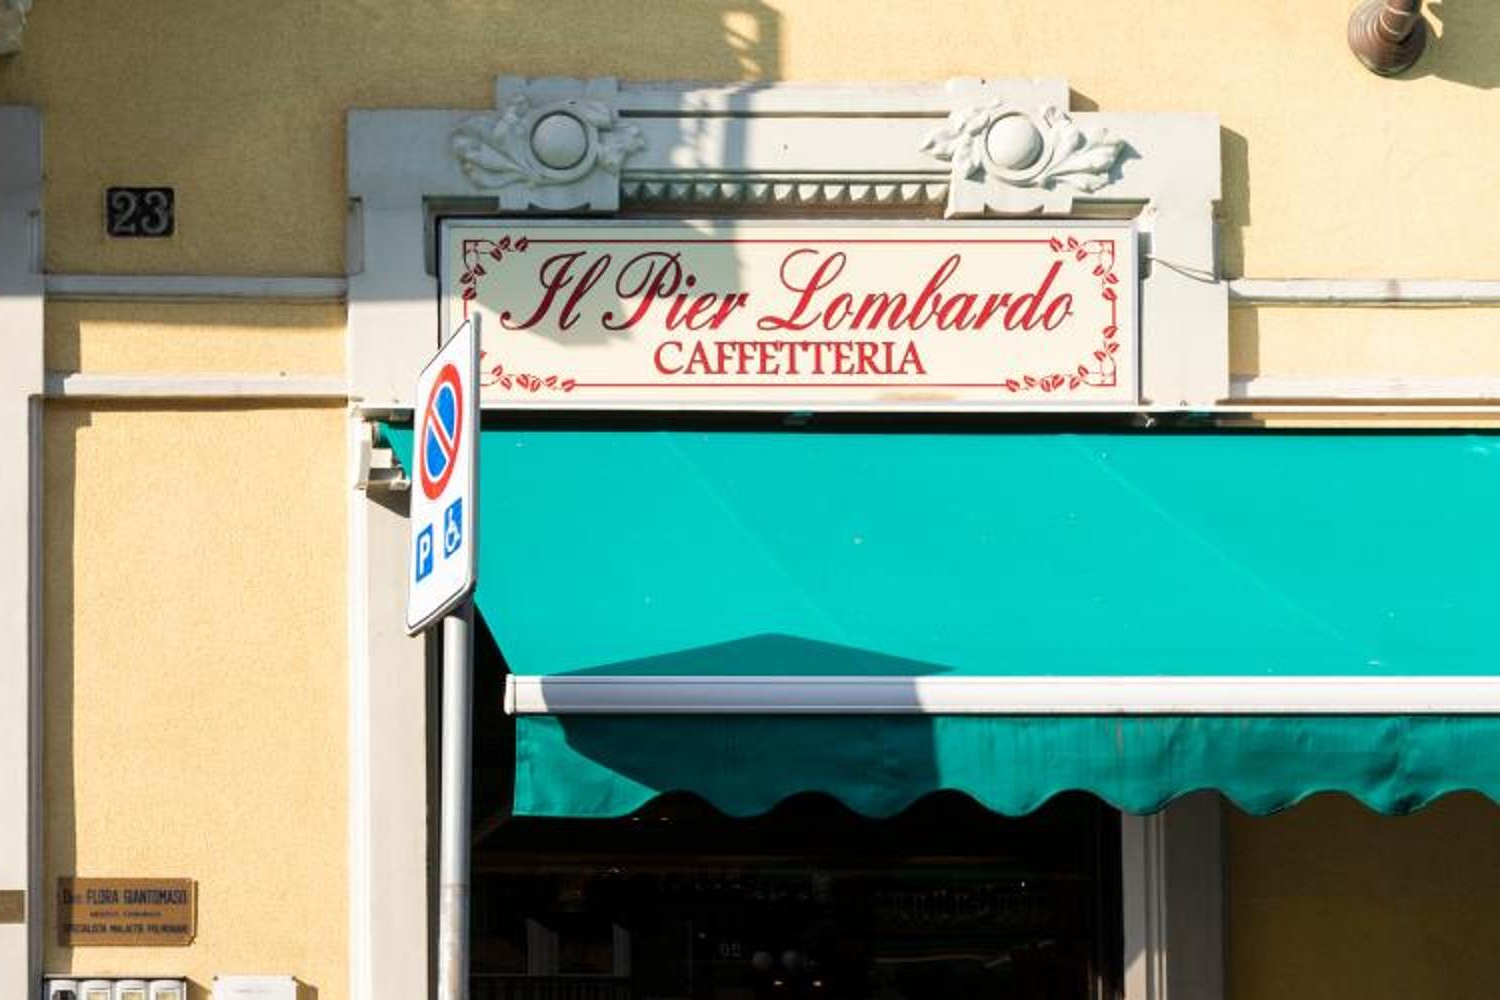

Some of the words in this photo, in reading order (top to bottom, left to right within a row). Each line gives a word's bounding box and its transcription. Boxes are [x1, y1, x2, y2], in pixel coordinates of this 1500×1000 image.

[111, 190, 169, 234] 23
[500, 251, 601, 332] Il
[601, 251, 747, 332] Pier
[757, 248, 1074, 332] Lombardo
[653, 339, 926, 375] CAFFETTERIA
[419, 532, 431, 576] P
[87, 888, 119, 905] FLORA
